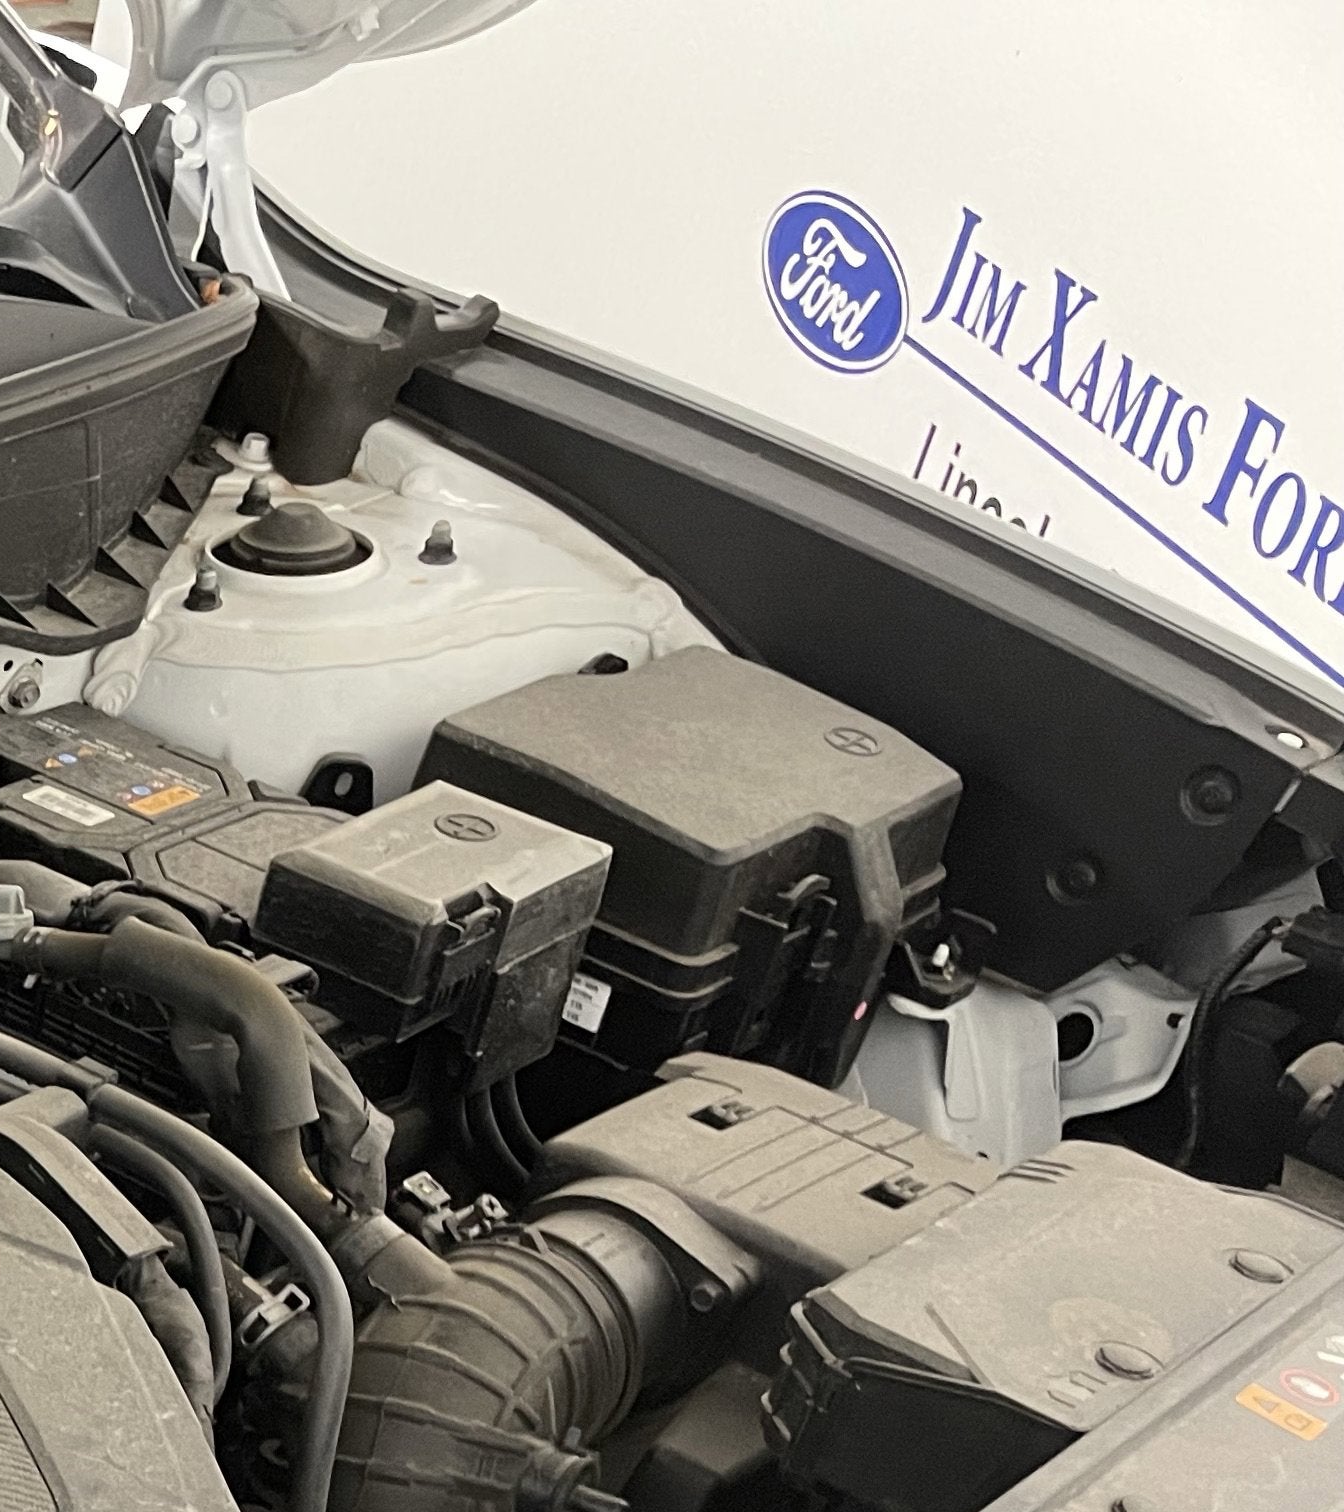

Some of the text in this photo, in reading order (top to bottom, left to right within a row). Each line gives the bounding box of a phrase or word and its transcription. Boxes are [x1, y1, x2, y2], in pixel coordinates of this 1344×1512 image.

[780, 217, 881, 351] Ford
[921, 206, 1344, 617] JIM XAMIS FOR
